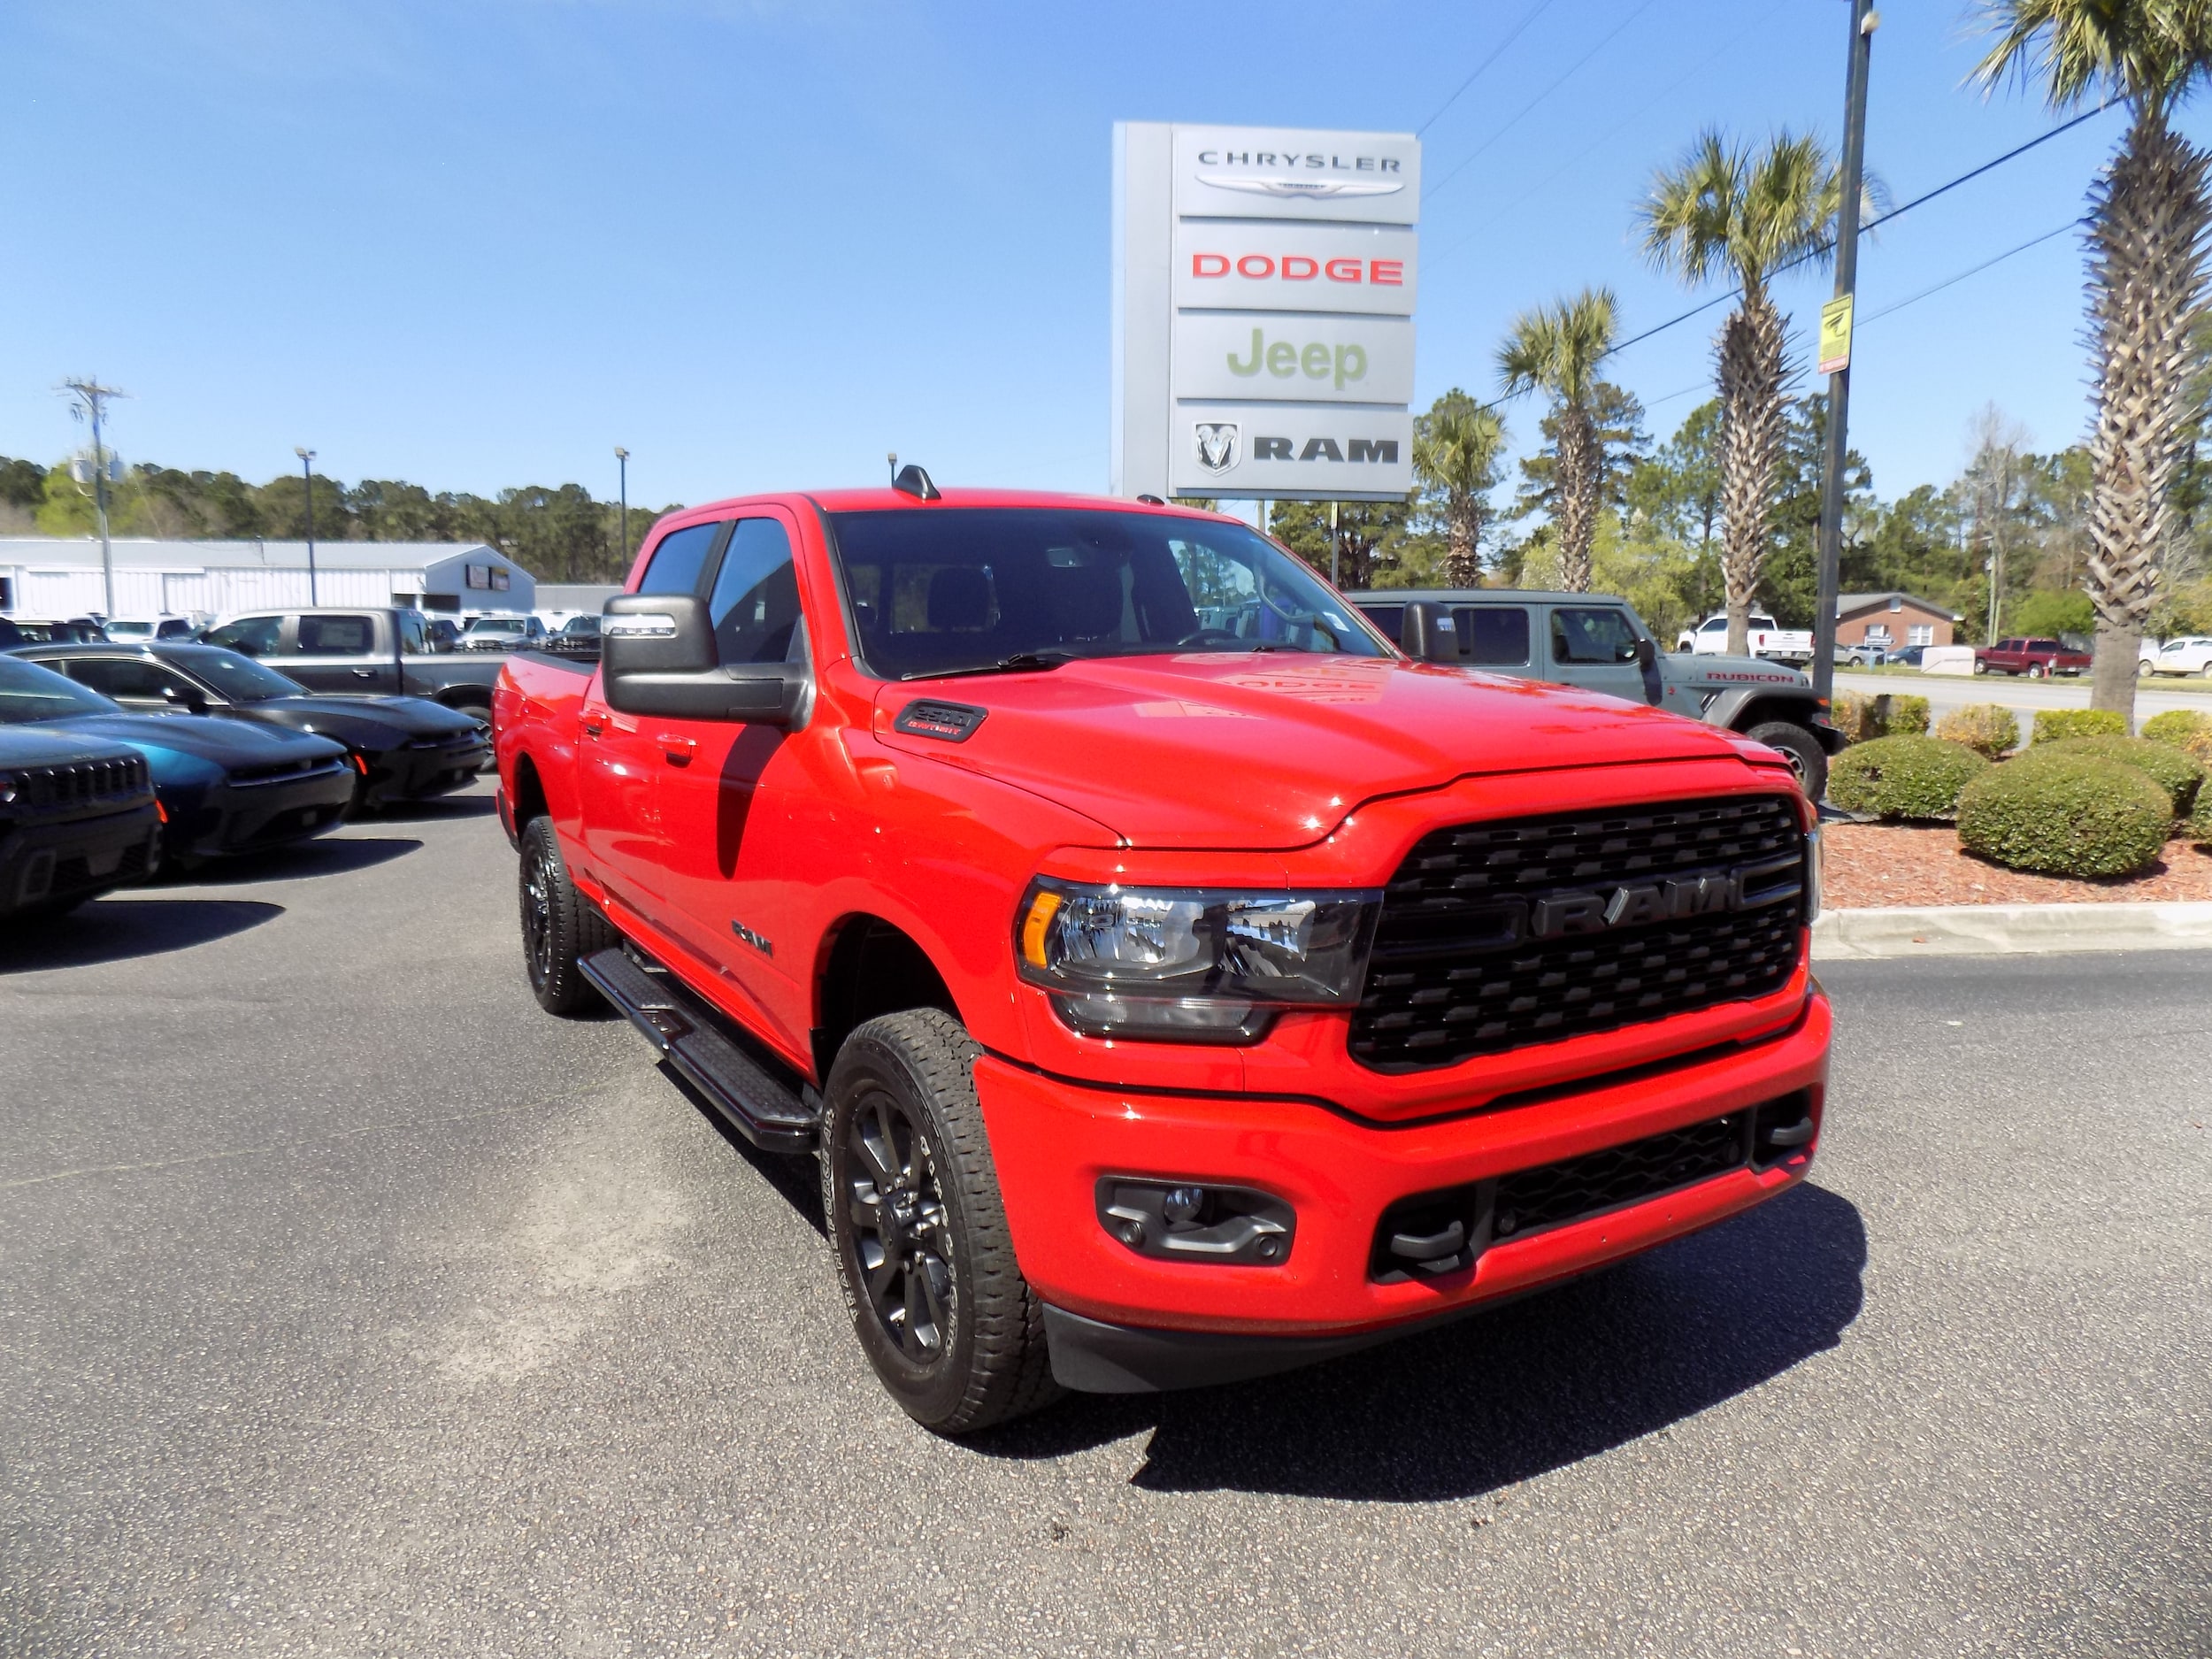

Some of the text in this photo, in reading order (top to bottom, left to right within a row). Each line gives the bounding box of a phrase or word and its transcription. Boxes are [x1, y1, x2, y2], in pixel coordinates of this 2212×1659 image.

[1198, 150, 1402, 173] CHRYSLER
[1192, 253, 1404, 287] DODGE
[1226, 326, 1368, 390] Jeep
[1254, 435, 1399, 465] RAM
[1706, 672, 1795, 683] RUBICON
[1532, 875, 1737, 938] RAM
[822, 1148, 859, 1323] TRANSFORCE
